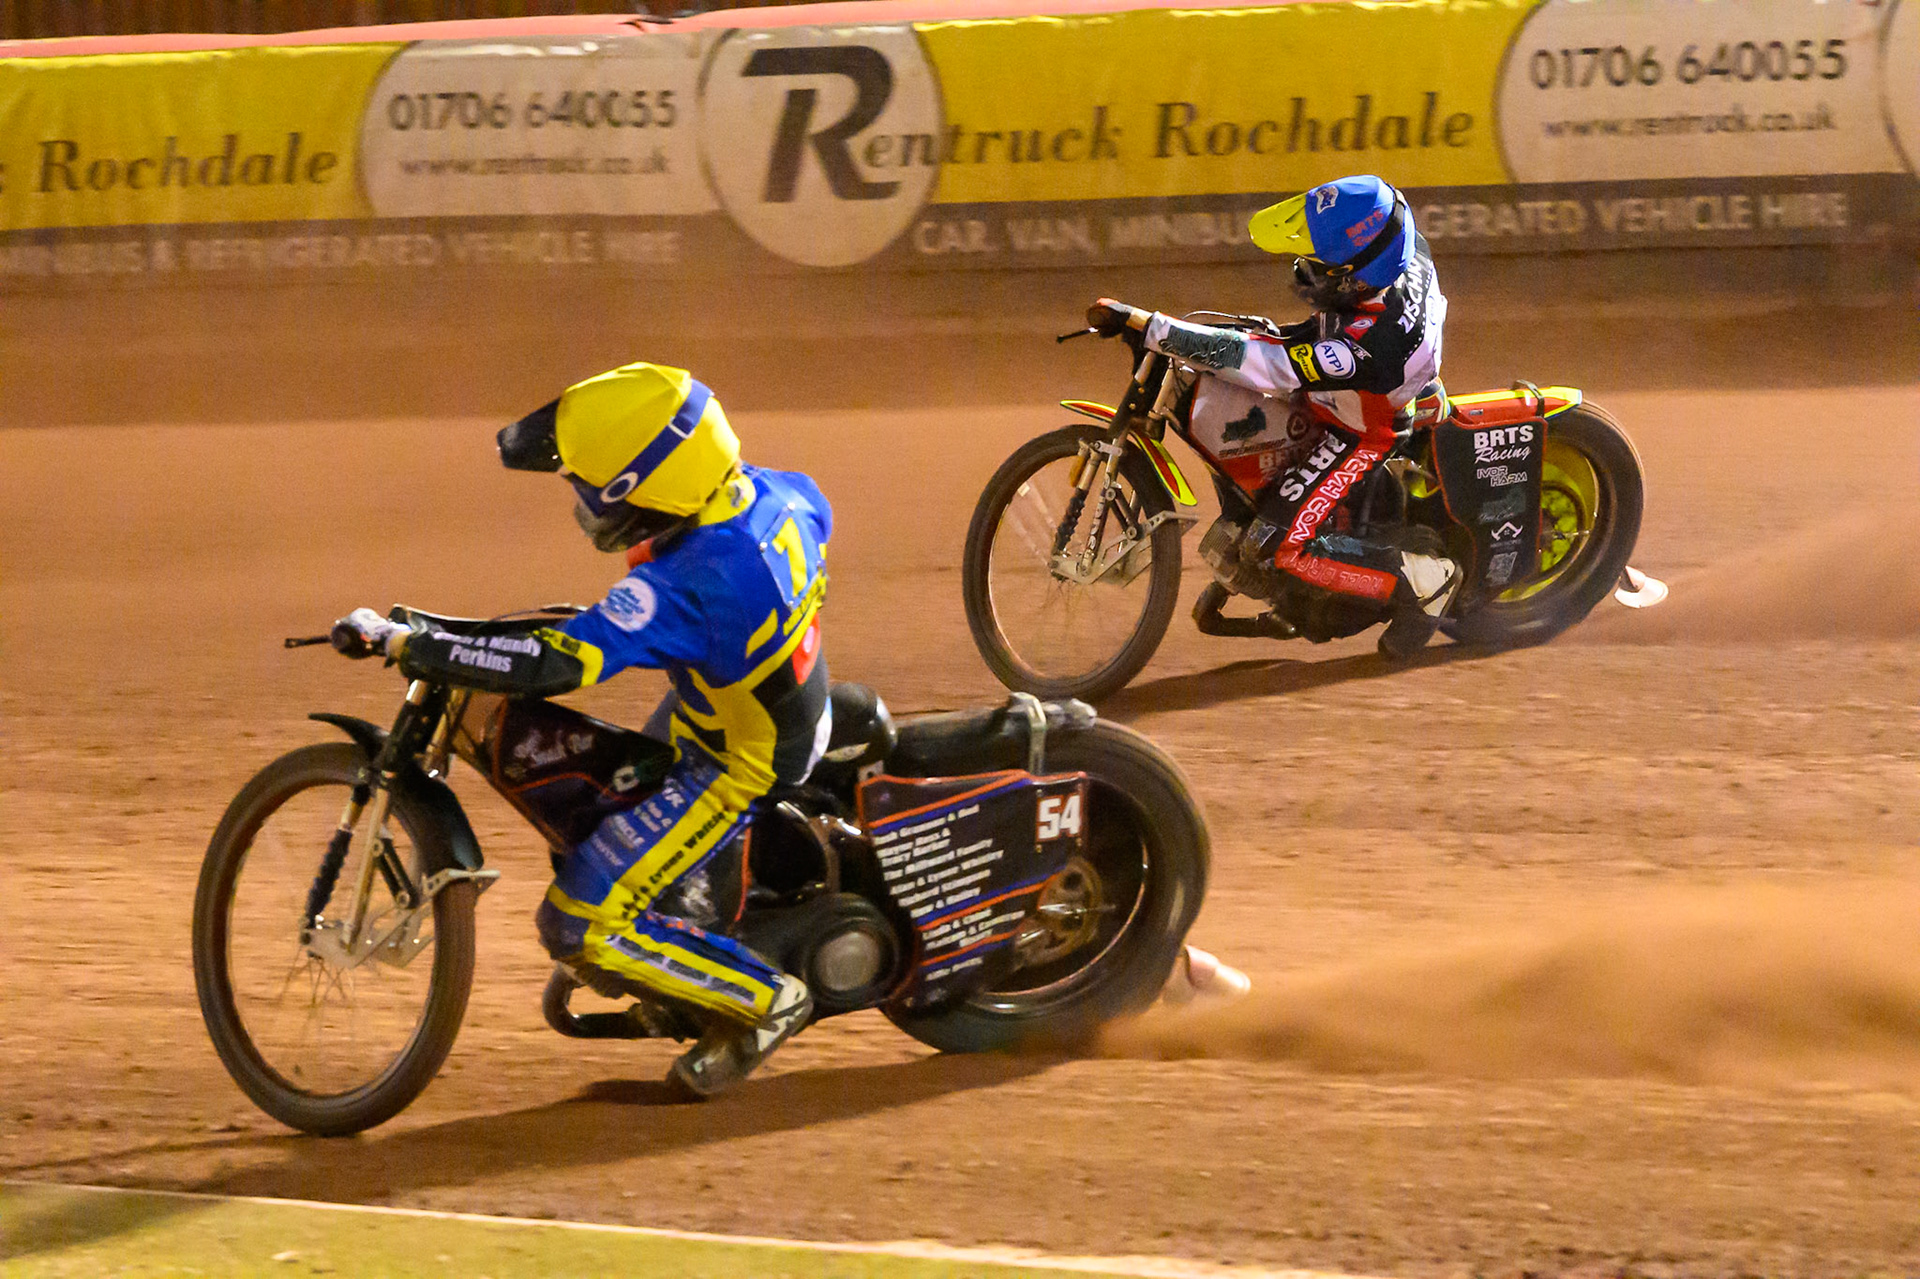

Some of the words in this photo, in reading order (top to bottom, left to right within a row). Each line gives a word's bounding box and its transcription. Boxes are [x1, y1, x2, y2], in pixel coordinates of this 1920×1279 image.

[1529, 46, 1662, 89] 01706
[1677, 39, 1848, 84] 640055
[388, 90, 513, 131] 01706
[524, 89, 676, 129] 640055
[741, 45, 1123, 202] Rentruck
[1153, 94, 1474, 159] Rochdale
[38, 131, 338, 193] Rochdale
[1107, 211, 1250, 250] MINIBU
[1424, 199, 1588, 239] GERATED
[1595, 195, 1753, 232] VEHICLE
[1759, 193, 1849, 228] HIRE
[1321, 344, 1345, 373] ATPI
[1473, 425, 1534, 451] BRTS
[1474, 444, 1532, 464] Racing
[1319, 447, 1380, 500] HARM
[1476, 465, 1508, 480] IVOR
[1490, 471, 1528, 488] HARM
[772, 517, 808, 598] 1
[449, 644, 513, 673] Perkins
[1038, 794, 1081, 840] 54
